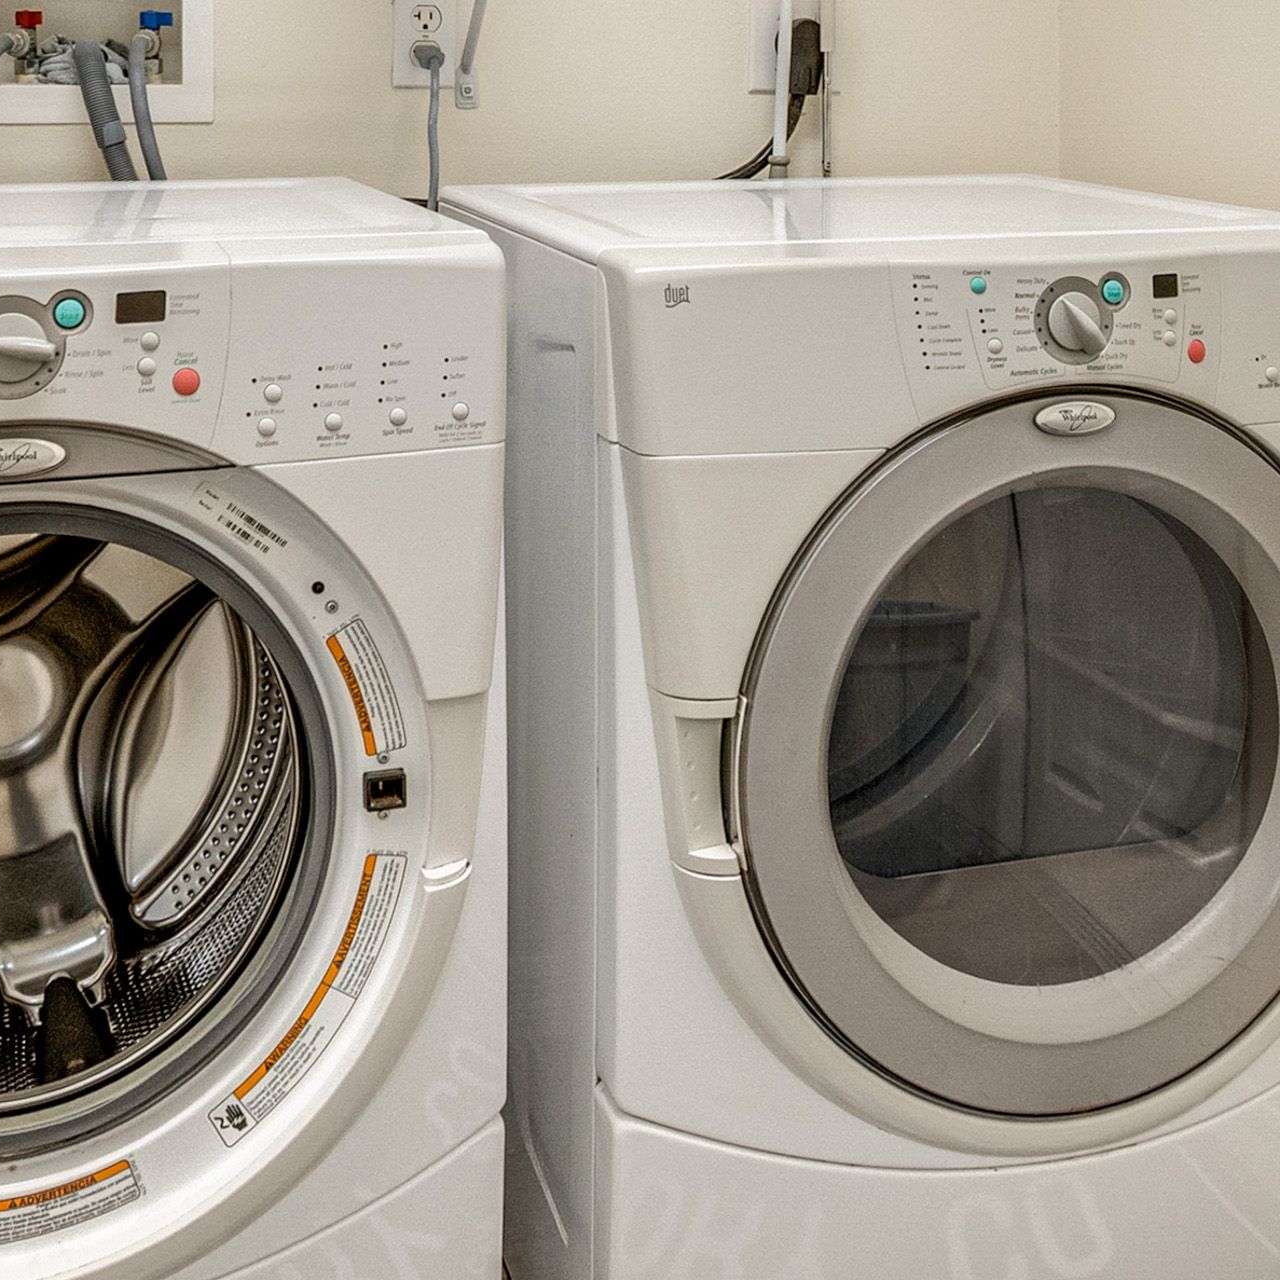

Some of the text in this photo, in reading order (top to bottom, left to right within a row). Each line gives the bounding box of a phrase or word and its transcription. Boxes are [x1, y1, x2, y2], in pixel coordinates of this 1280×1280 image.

[664, 284, 690, 307] duet
[337, 874, 372, 960] AVERTISSEMENT
[270, 1017, 308, 1066] WARNING
[19, 1176, 97, 1207] ADVERTENCIA
